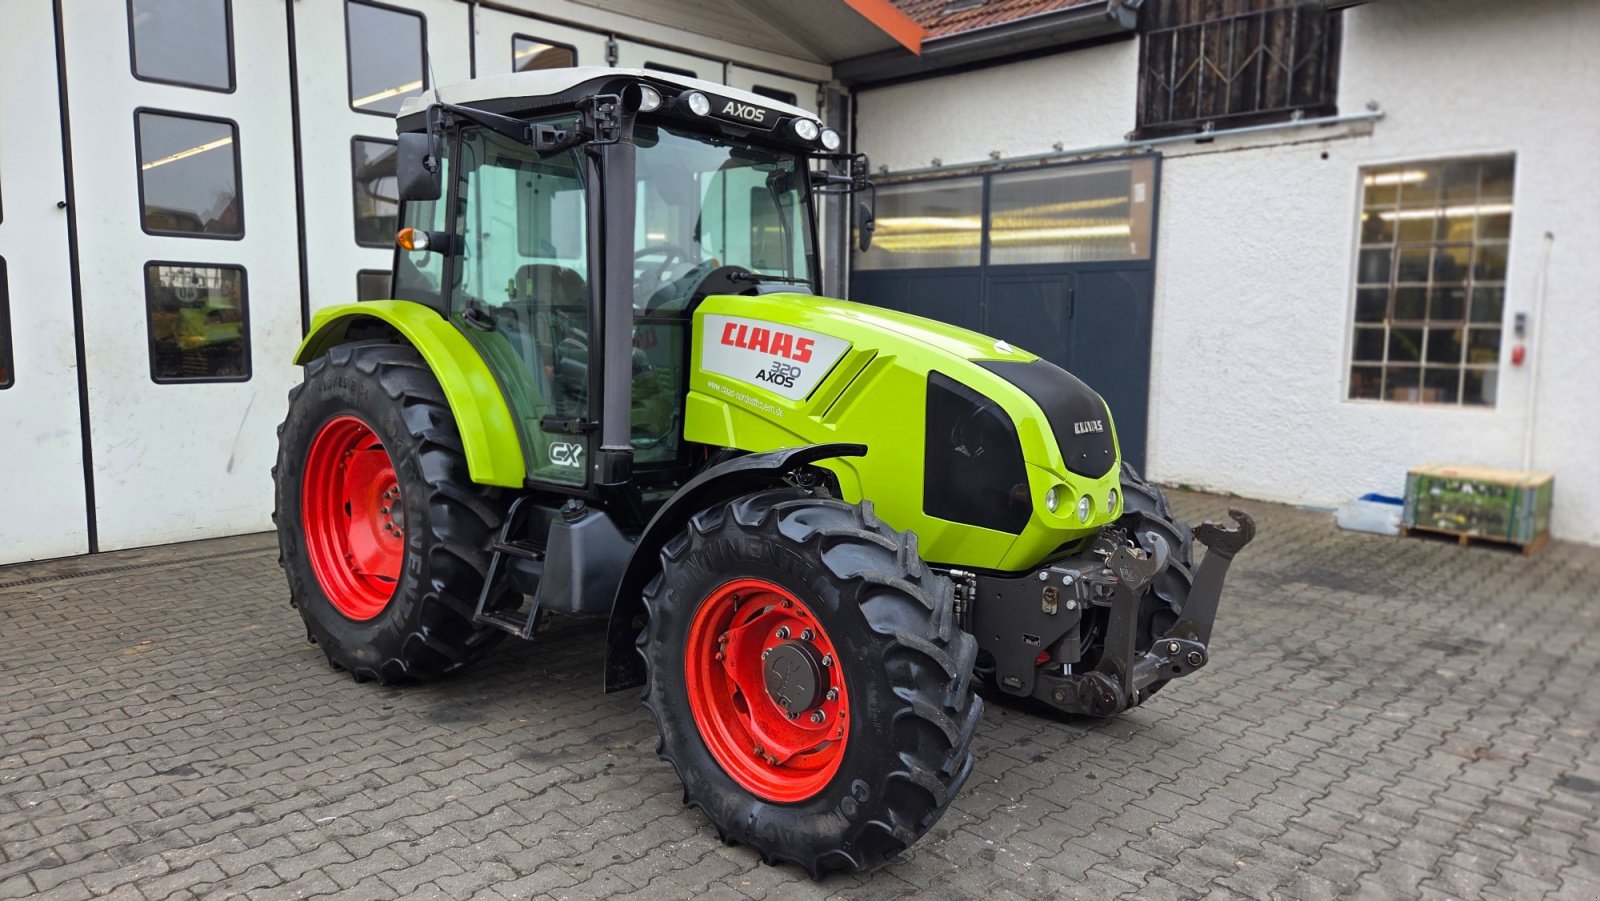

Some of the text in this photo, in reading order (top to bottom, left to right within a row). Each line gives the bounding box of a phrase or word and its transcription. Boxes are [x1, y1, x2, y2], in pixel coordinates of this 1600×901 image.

[722, 101, 766, 122] AXOS
[720, 322, 815, 364] CLAAS
[755, 369, 796, 389] AXOS
[770, 361, 802, 379] 320
[1074, 420, 1104, 434] CLAAS
[549, 442, 583, 468] CX
